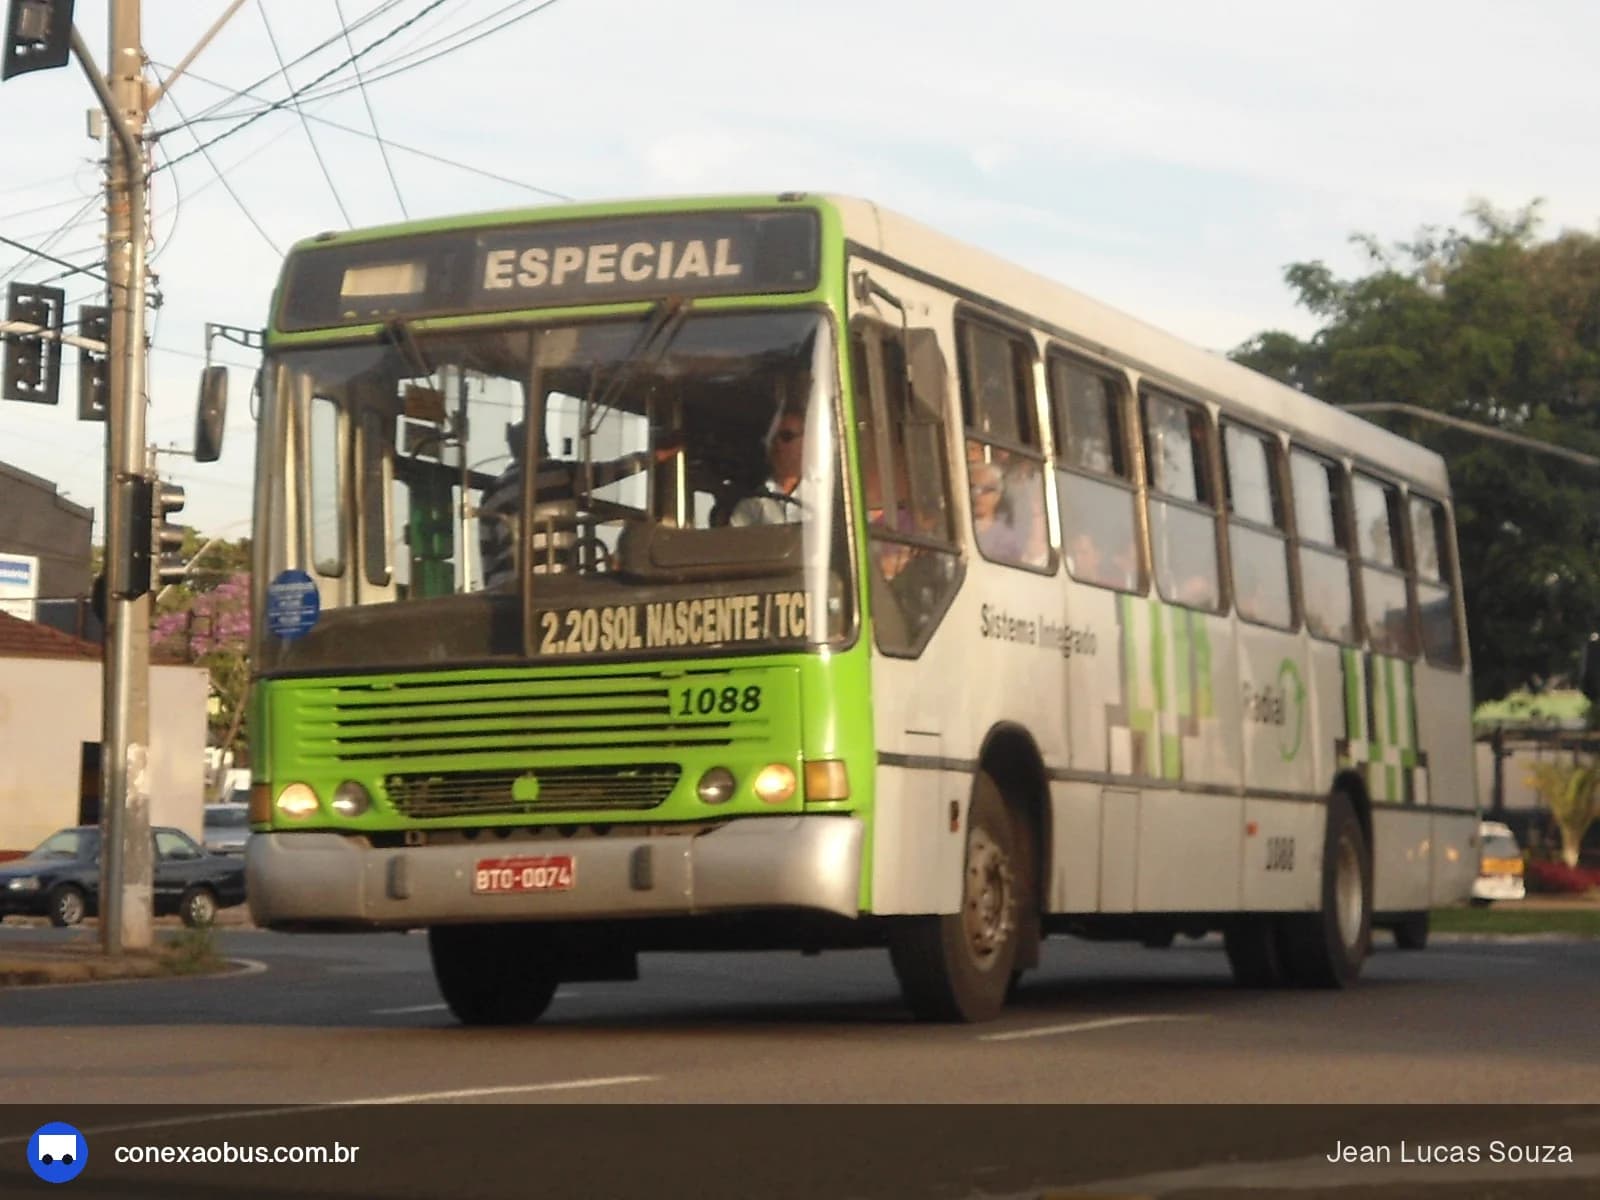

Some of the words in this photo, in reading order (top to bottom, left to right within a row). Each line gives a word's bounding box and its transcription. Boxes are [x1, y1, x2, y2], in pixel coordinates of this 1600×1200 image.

[483, 238, 742, 289] ESPECIAL
[540, 609, 599, 654] 2.20
[600, 606, 642, 650] SOL
[646, 596, 759, 647] NASCENTE
[979, 602, 1036, 645] Sistema
[680, 686, 762, 716] 1088
